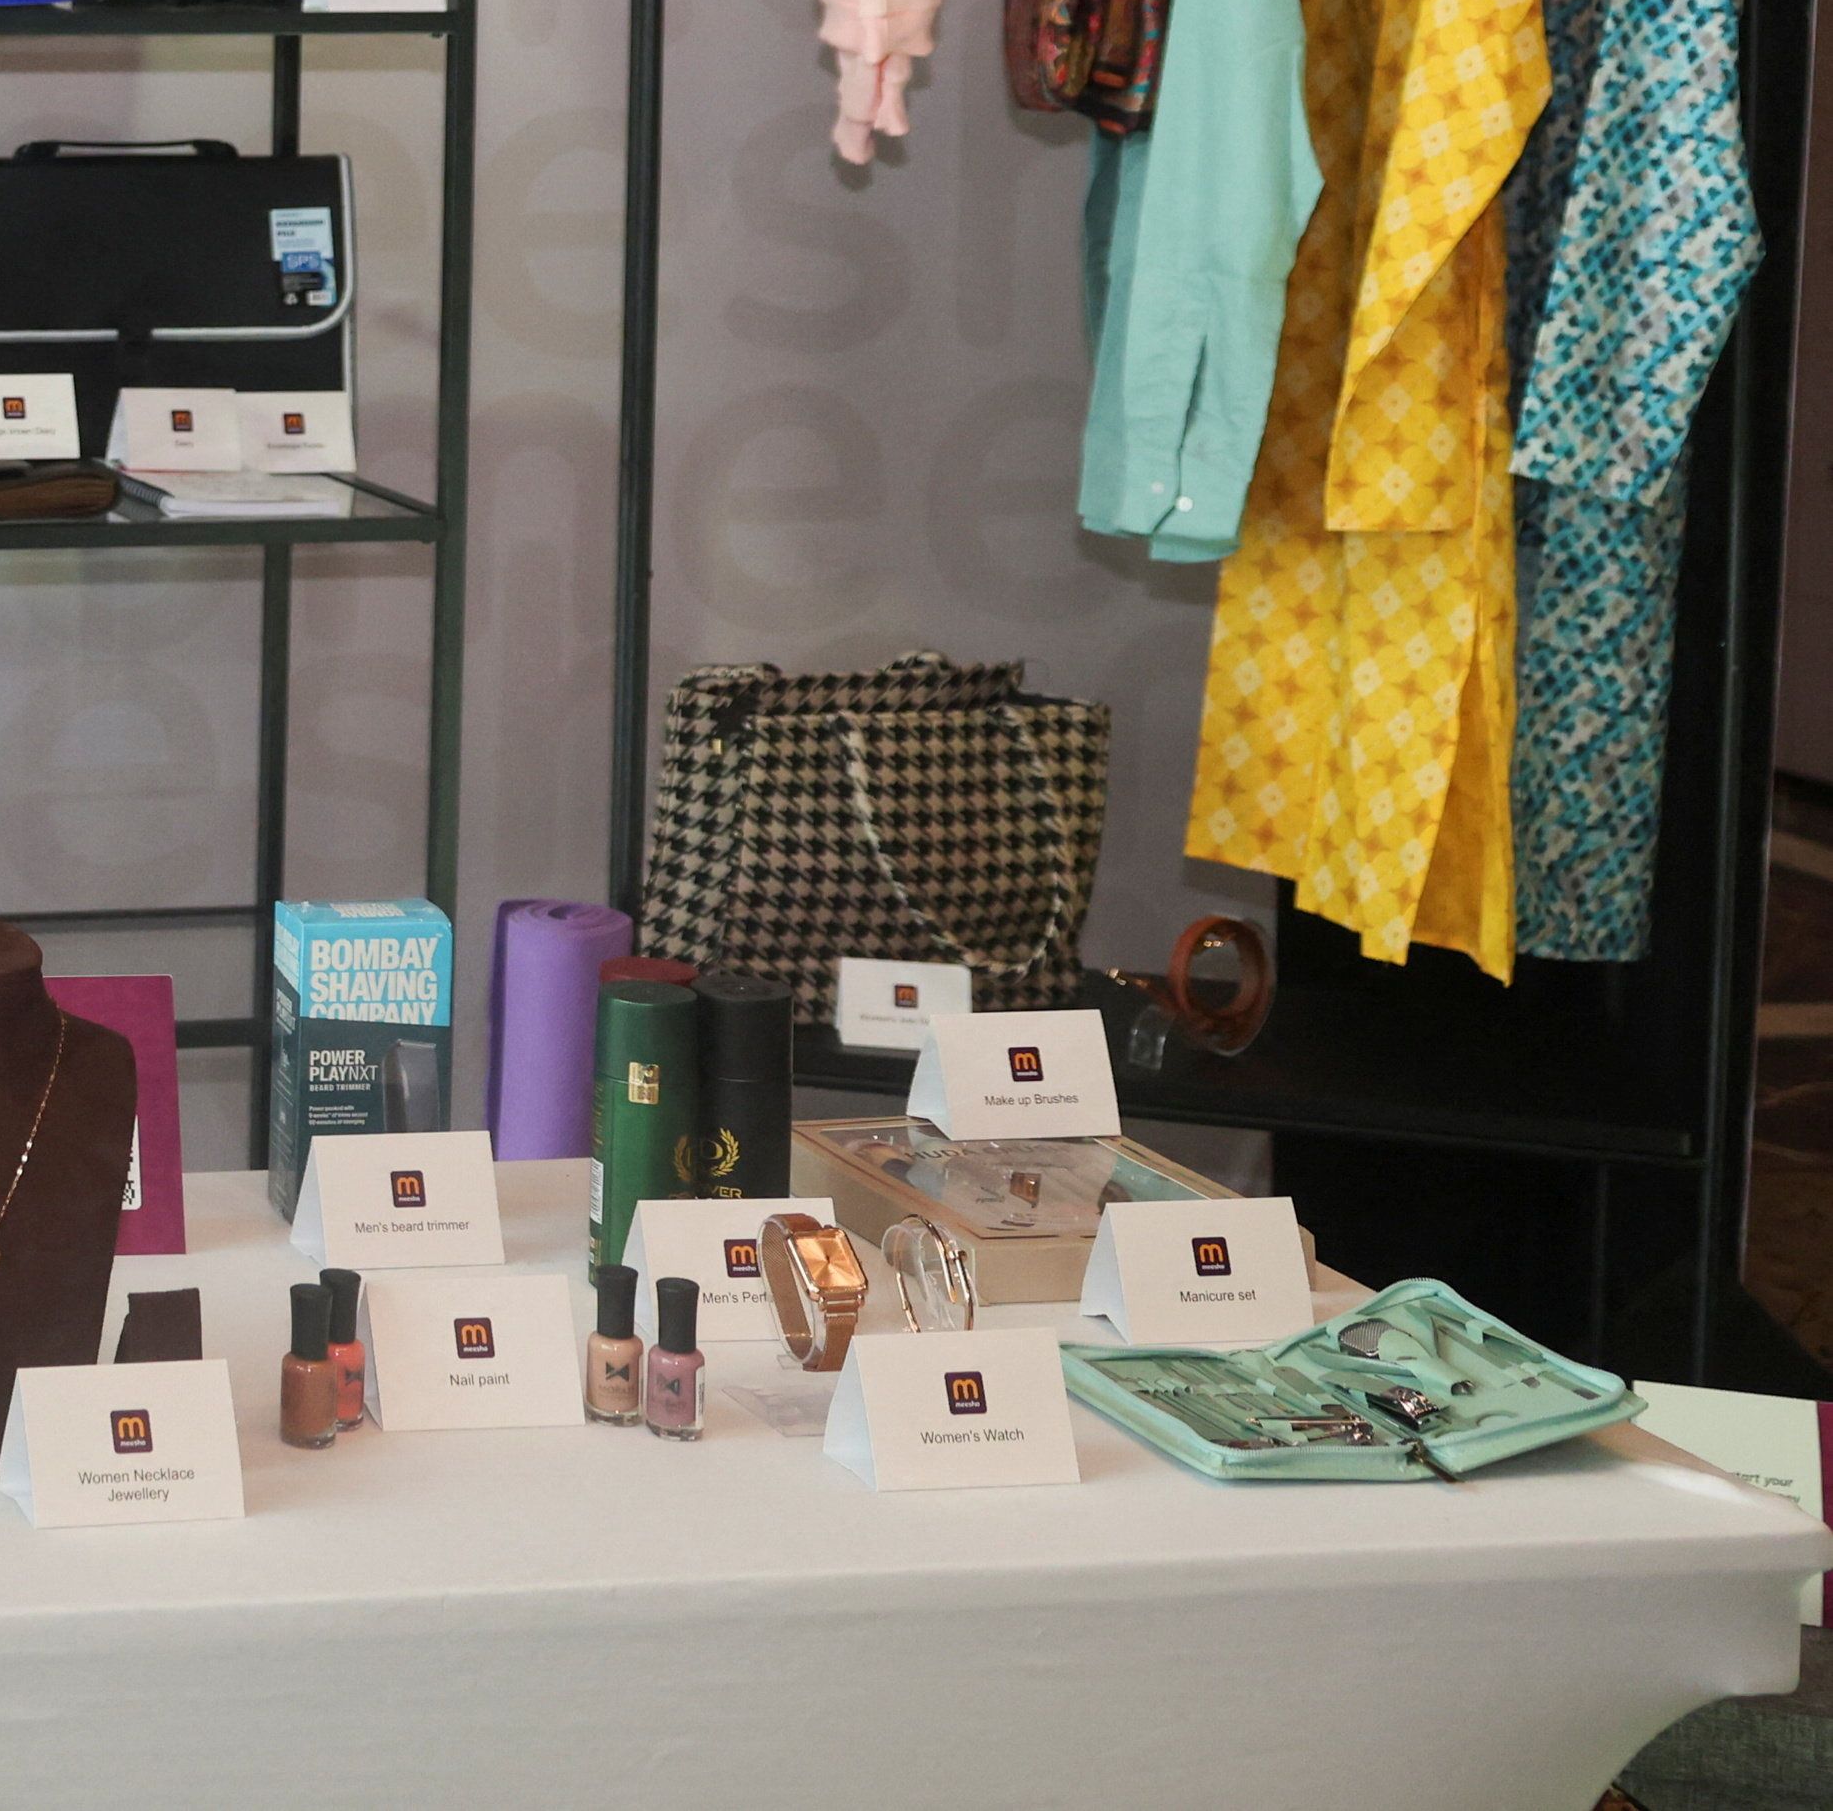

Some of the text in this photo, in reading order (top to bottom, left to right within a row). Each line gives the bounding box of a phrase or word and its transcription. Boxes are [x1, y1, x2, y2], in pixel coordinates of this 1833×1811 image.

[309, 937, 439, 971] BOMBAY
[309, 969, 438, 1002] SHAVING
[308, 1001, 437, 1026] COMPANY
[309, 1050, 366, 1066] POWER
[309, 1065, 379, 1082] PLAYNXT
[309, 1083, 371, 1092] BEARD TRIMMER
[984, 1093, 1079, 1107] Make up Brushes
[355, 1219, 470, 1234] Men's beard trimmer
[702, 1292, 739, 1304] Men's
[1180, 1289, 1257, 1303] Manicure set
[450, 1373, 510, 1388] Nail paint
[920, 1428, 1025, 1444] Women's Watch
[78, 1467, 195, 1485] Women Necklace
[1764, 1477, 1793, 1487] your
[108, 1487, 170, 1503] Jewellery
